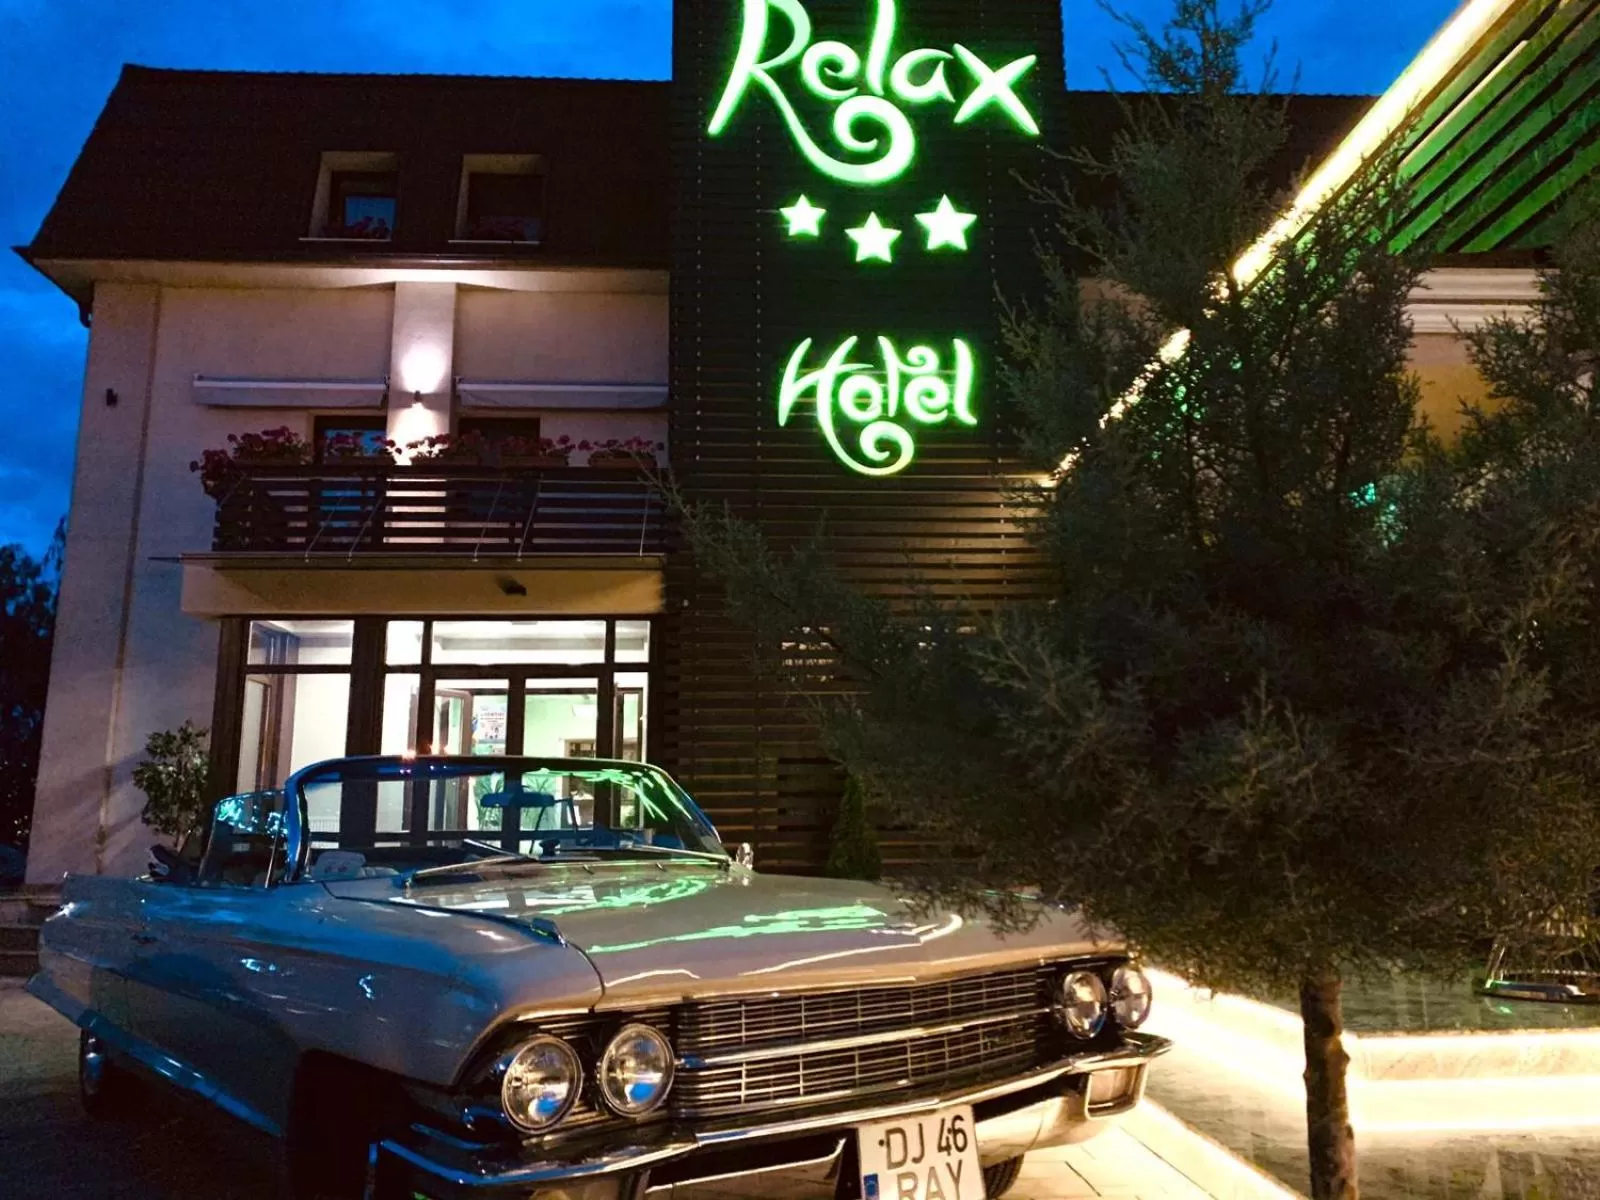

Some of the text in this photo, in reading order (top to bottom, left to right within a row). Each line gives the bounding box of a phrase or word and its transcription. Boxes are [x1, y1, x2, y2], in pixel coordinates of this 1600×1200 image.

[707, 0, 1040, 183] Relax
[778, 335, 977, 476] Hotel
[885, 1115, 968, 1170] DJ 46
[897, 1159, 963, 1200] RAY
